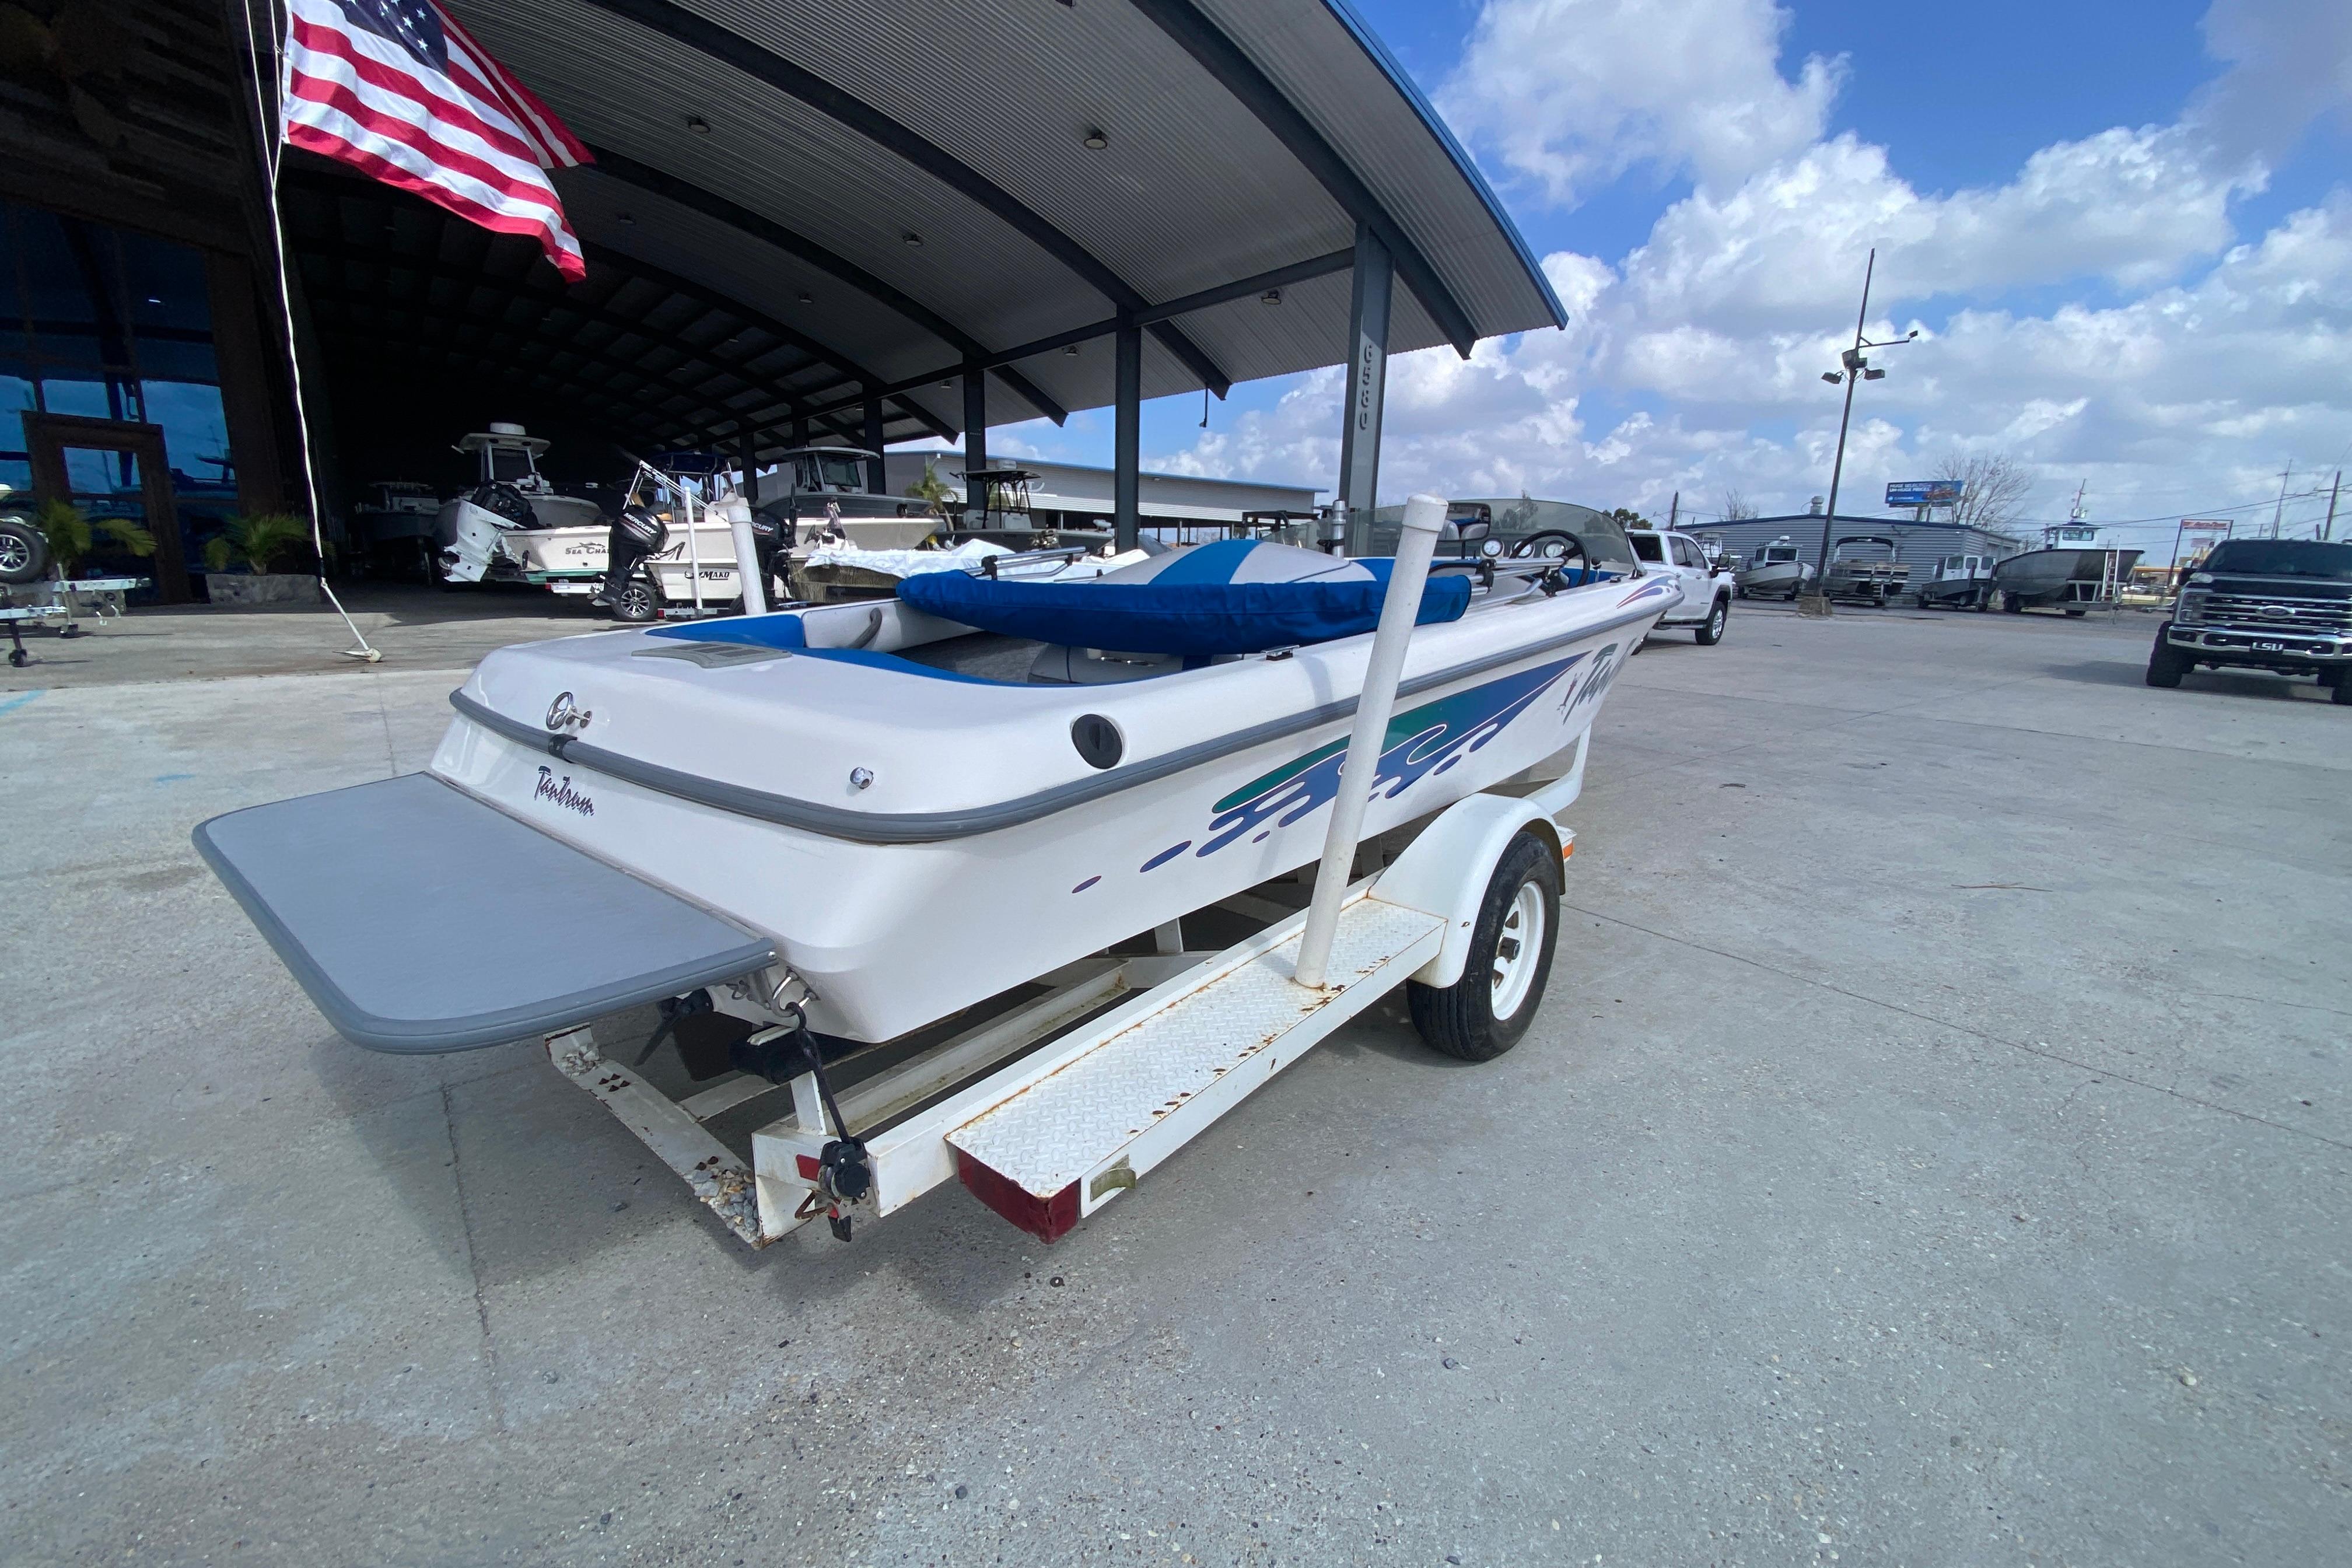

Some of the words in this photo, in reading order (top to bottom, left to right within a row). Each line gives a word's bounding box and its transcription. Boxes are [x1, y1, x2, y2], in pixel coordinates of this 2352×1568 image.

[624, 513, 657, 533] MERCURY
[701, 571, 730, 580] MAKO
[2252, 642, 2284, 652] LSU
[534, 765, 595, 817] Tantrum
